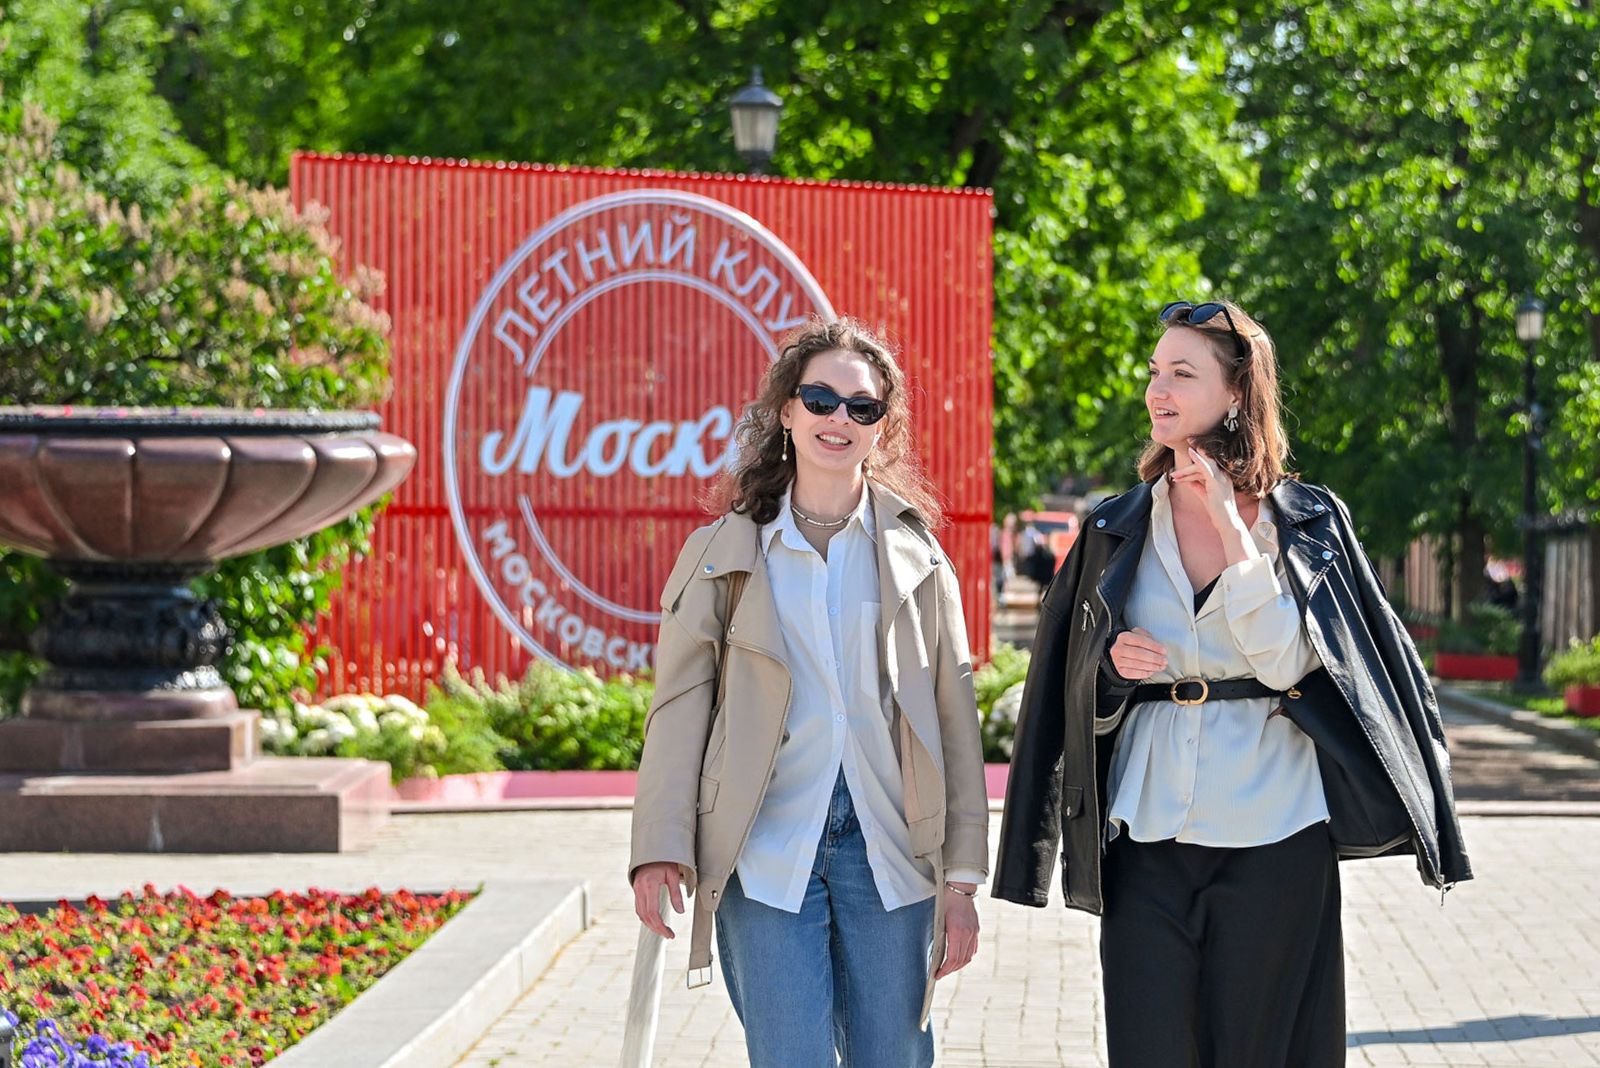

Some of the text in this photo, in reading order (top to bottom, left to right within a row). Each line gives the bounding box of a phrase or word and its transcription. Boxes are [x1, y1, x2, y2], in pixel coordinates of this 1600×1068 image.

[494, 212, 809, 365] ЛЕТНИЙ КЛУ
[480, 385, 740, 479] Моск
[482, 521, 657, 670] МОСКОВСК
